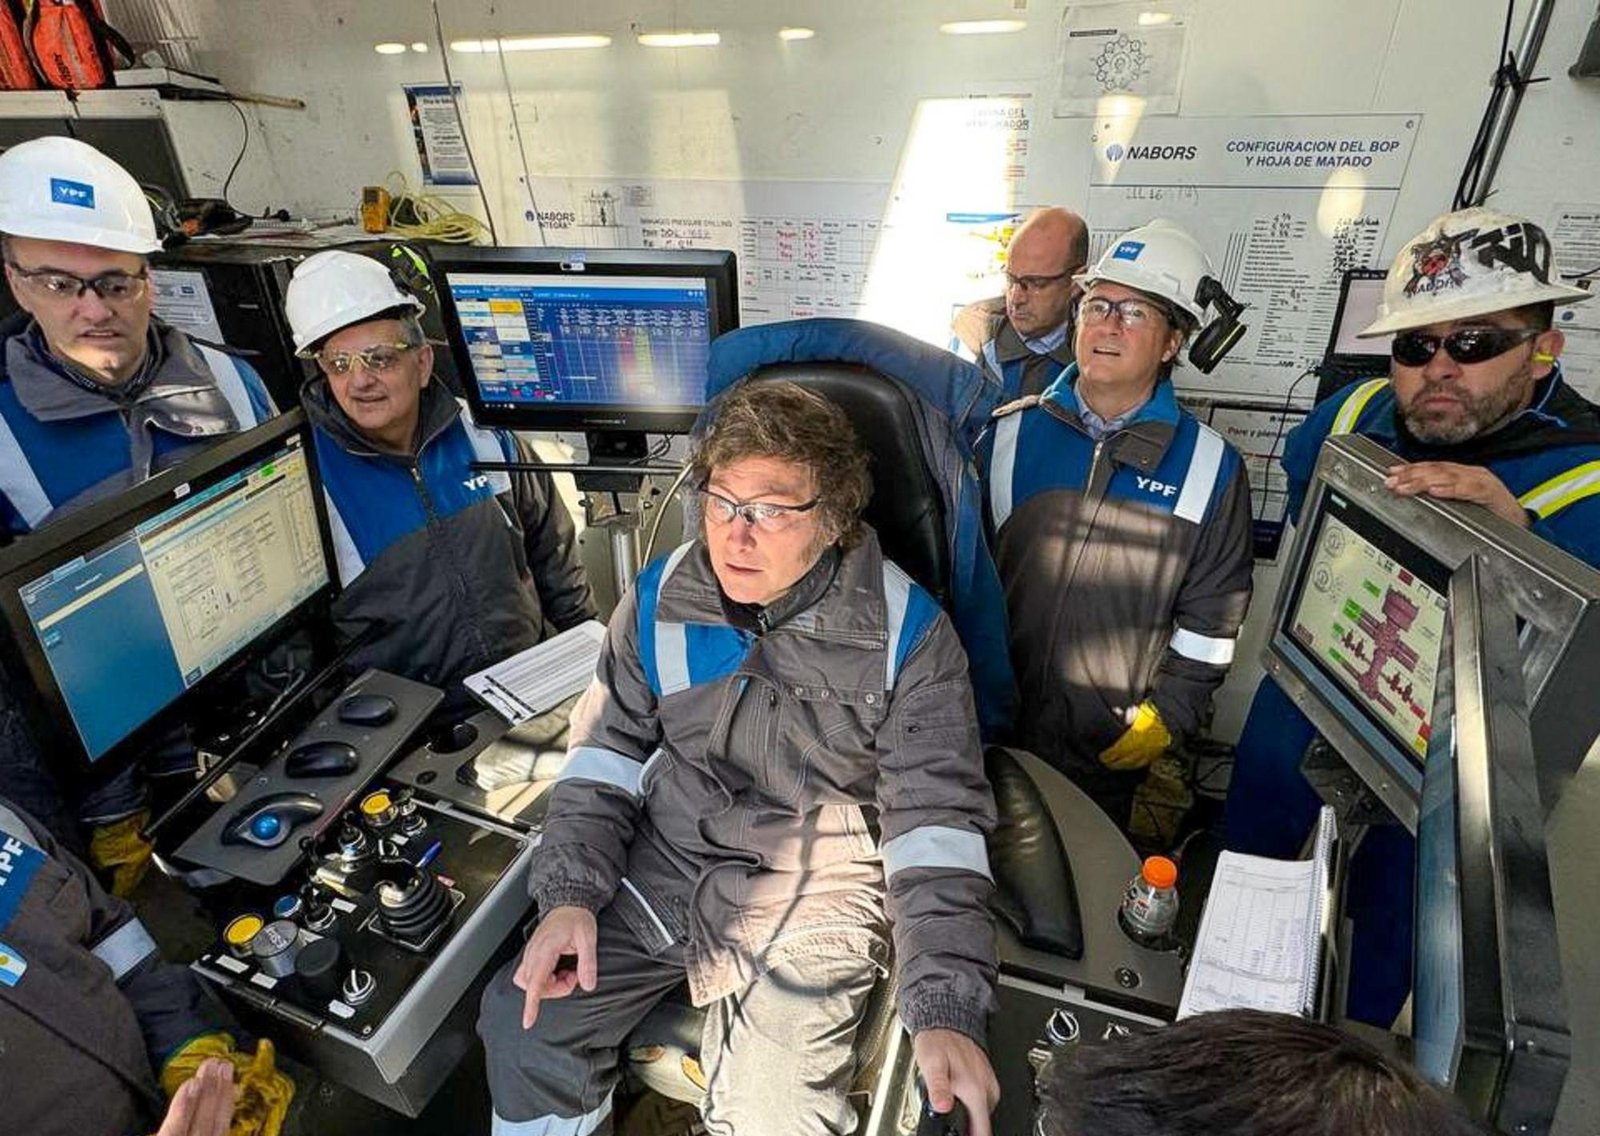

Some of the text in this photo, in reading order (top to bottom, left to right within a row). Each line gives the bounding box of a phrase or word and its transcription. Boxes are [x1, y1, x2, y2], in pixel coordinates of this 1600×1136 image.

[1126, 146, 1198, 160] NABORS
[1226, 141, 1400, 153] CONFIGURACION DEL BOP
[1246, 156, 1373, 168] Y HOJA DE MATADO
[58, 186, 88, 198] YPF
[536, 211, 576, 223] NABORS
[462, 474, 489, 490] YP
[1136, 475, 1178, 497] YPF
